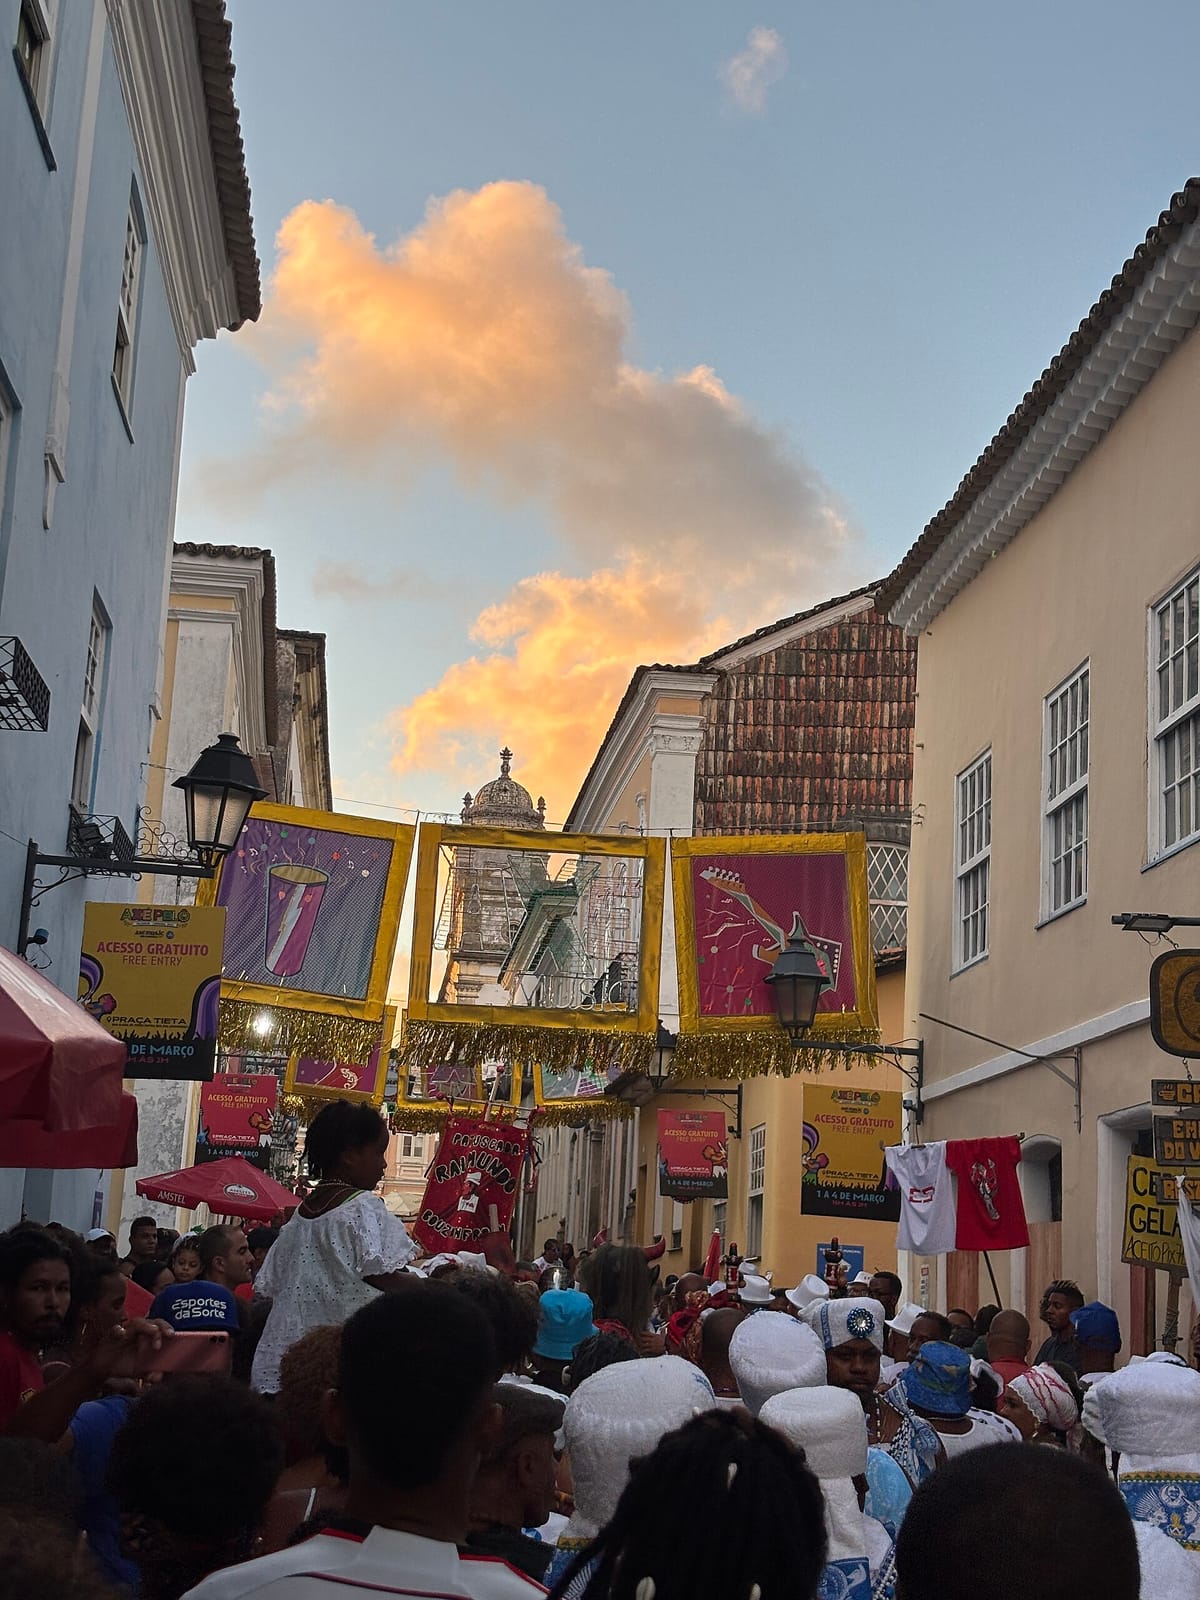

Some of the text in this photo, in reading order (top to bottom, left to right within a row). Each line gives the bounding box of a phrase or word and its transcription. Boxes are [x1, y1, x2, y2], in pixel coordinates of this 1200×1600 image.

[97, 942, 209, 956] ACESSO GRATUITO
[122, 955, 183, 966] FREE ENTRY
[112, 1016, 187, 1025] PRAÇA TIETA
[131, 1044, 194, 1058] DE MARÇO
[208, 1094, 268, 1104] ACESSO GRATUITO
[815, 1114, 894, 1128] ACESSO GRATUITO
[832, 1125, 875, 1135] FREE ENTRY
[1172, 1120, 1200, 1139] EM
[1164, 1141, 1185, 1160] DO
[435, 1150, 517, 1194] RAIMUNDO
[157, 1190, 186, 1204] AMSTEL
[816, 1190, 885, 1204] 1 A 4 DE MARÇO
[1129, 1203, 1182, 1239] GELA
[172, 1298, 227, 1310] Esportes
